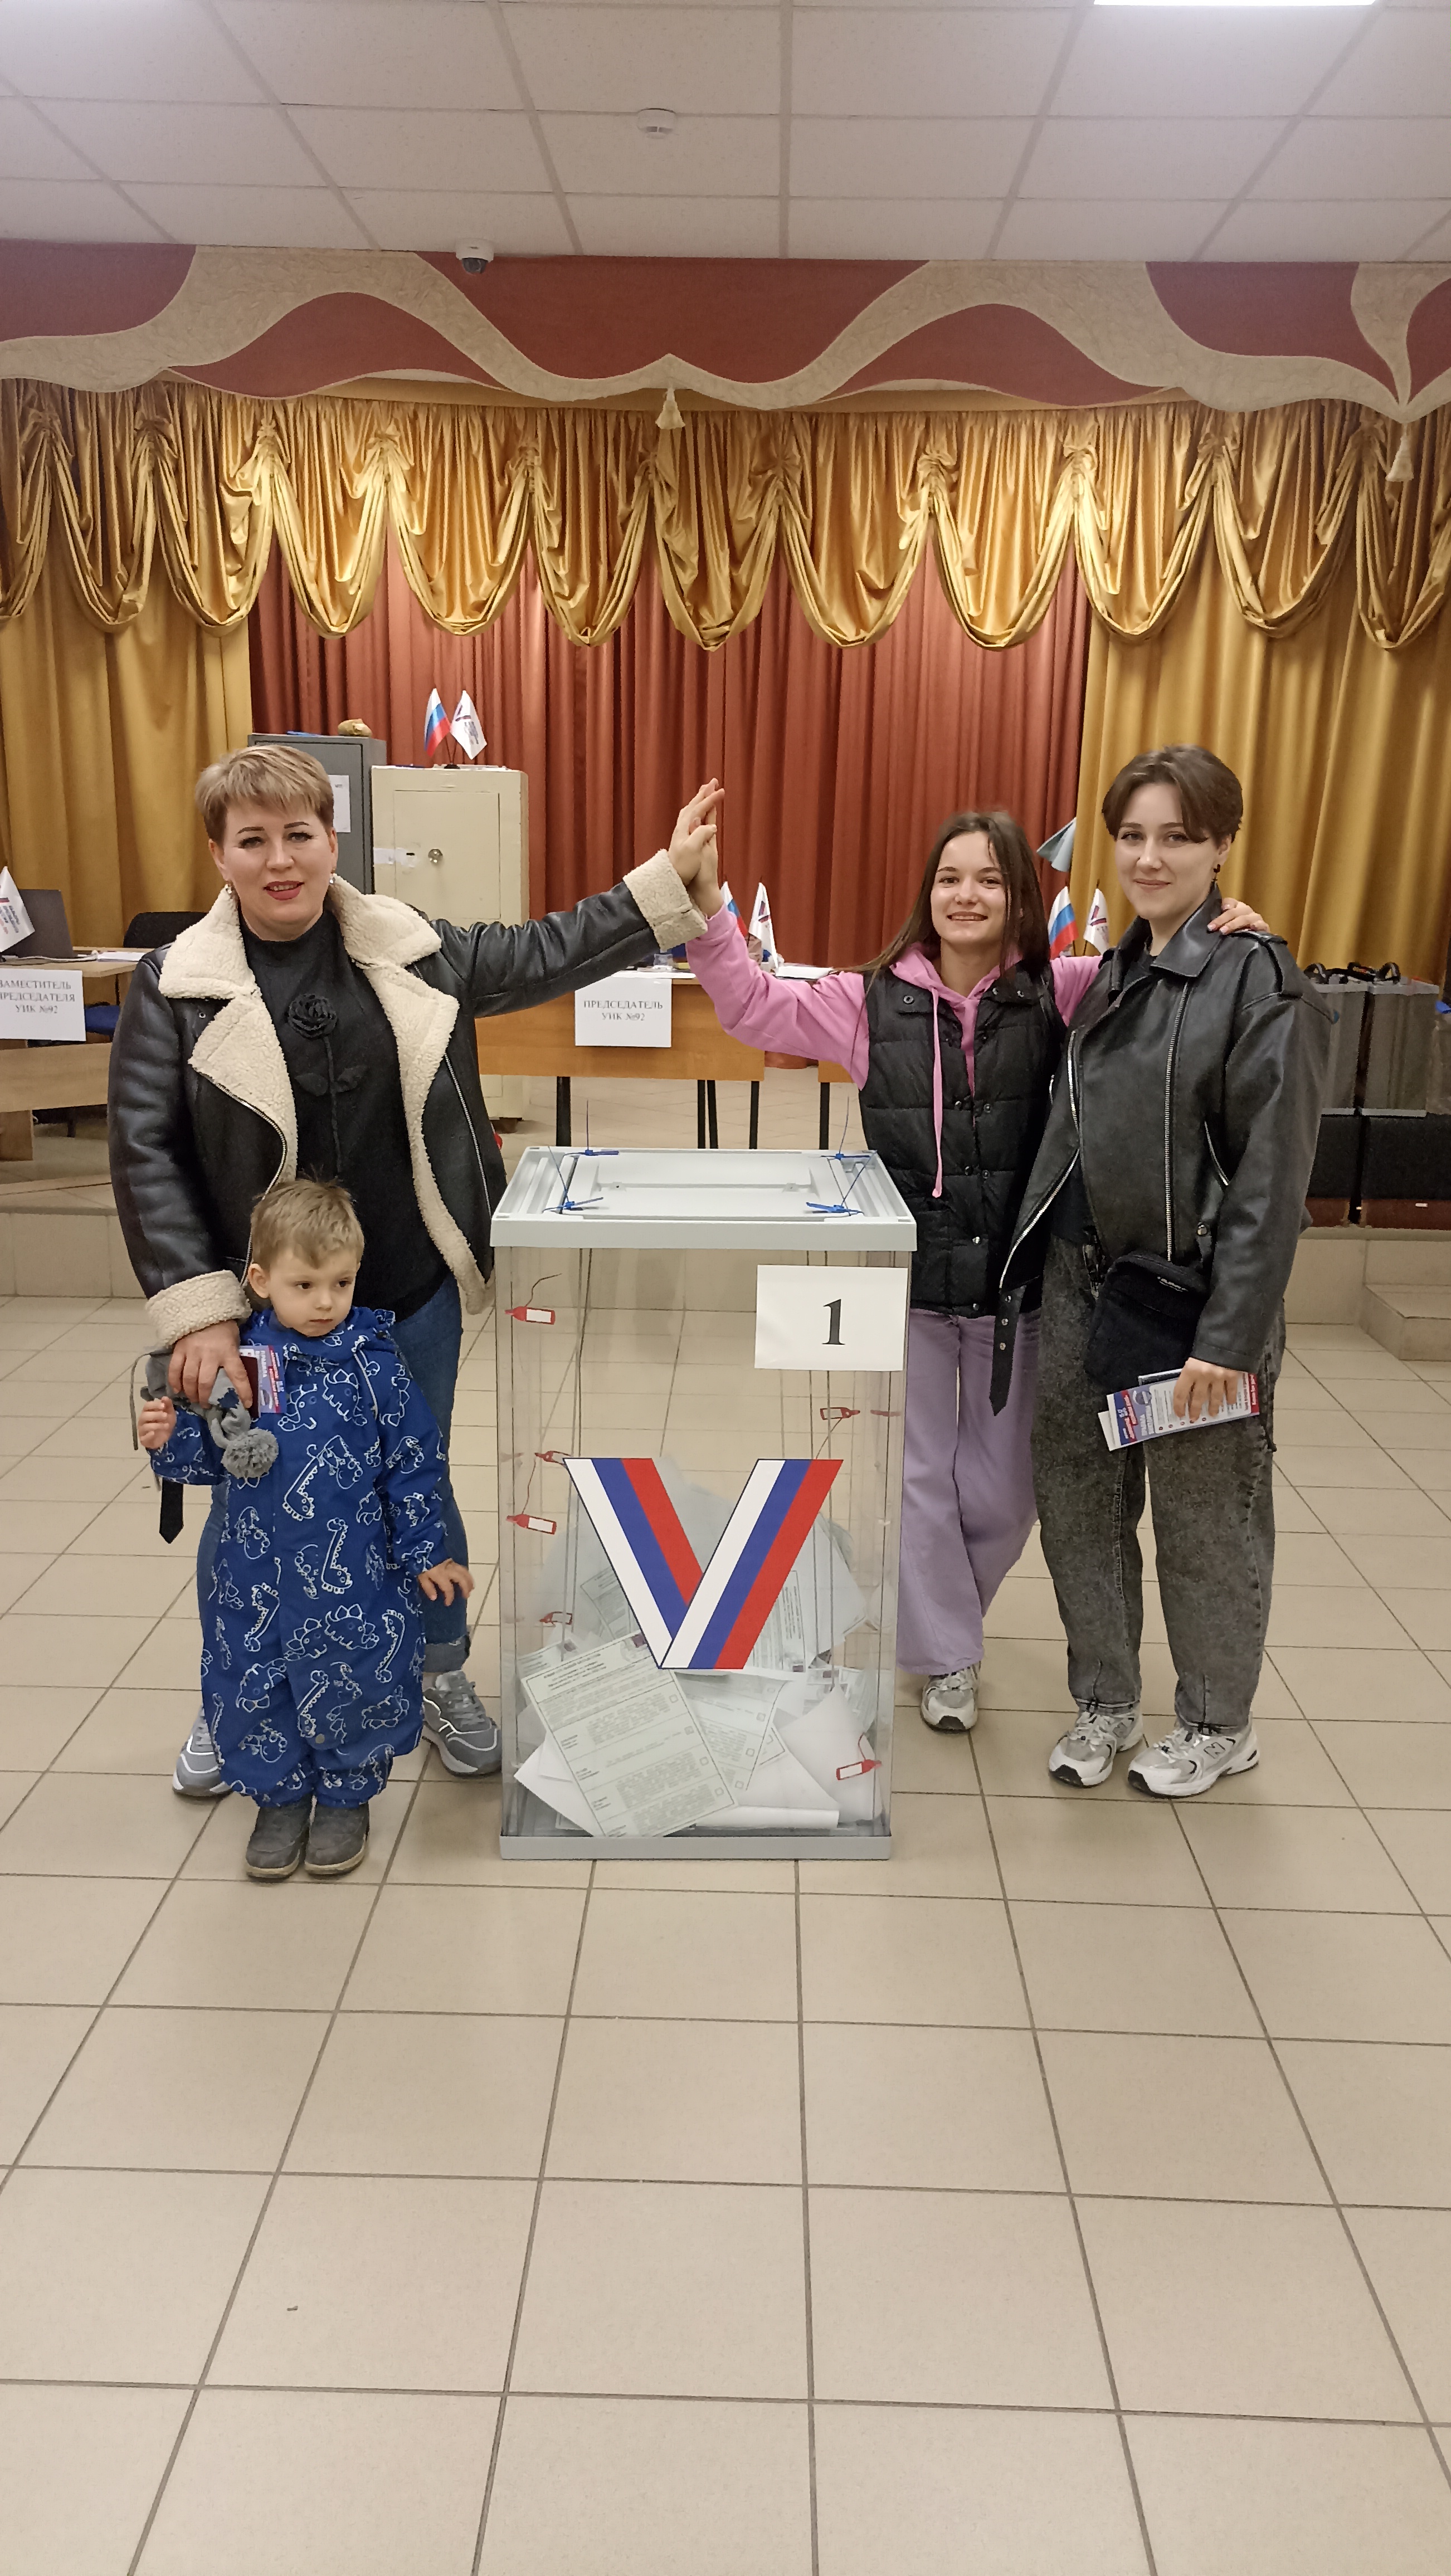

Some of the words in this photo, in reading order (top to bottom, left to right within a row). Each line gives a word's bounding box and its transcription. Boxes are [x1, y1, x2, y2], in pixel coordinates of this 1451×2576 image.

[15, 1004, 36, 1013] УИК
[39, 1005, 58, 1014] №92
[583, 1000, 664, 1009] ПРЕДСЕДАТЕЛЬ
[601, 1012, 622, 1021] УИК
[625, 1013, 645, 1021] №92
[821, 1299, 846, 1345] 1
[1203, 1741, 1226, 1759] N
